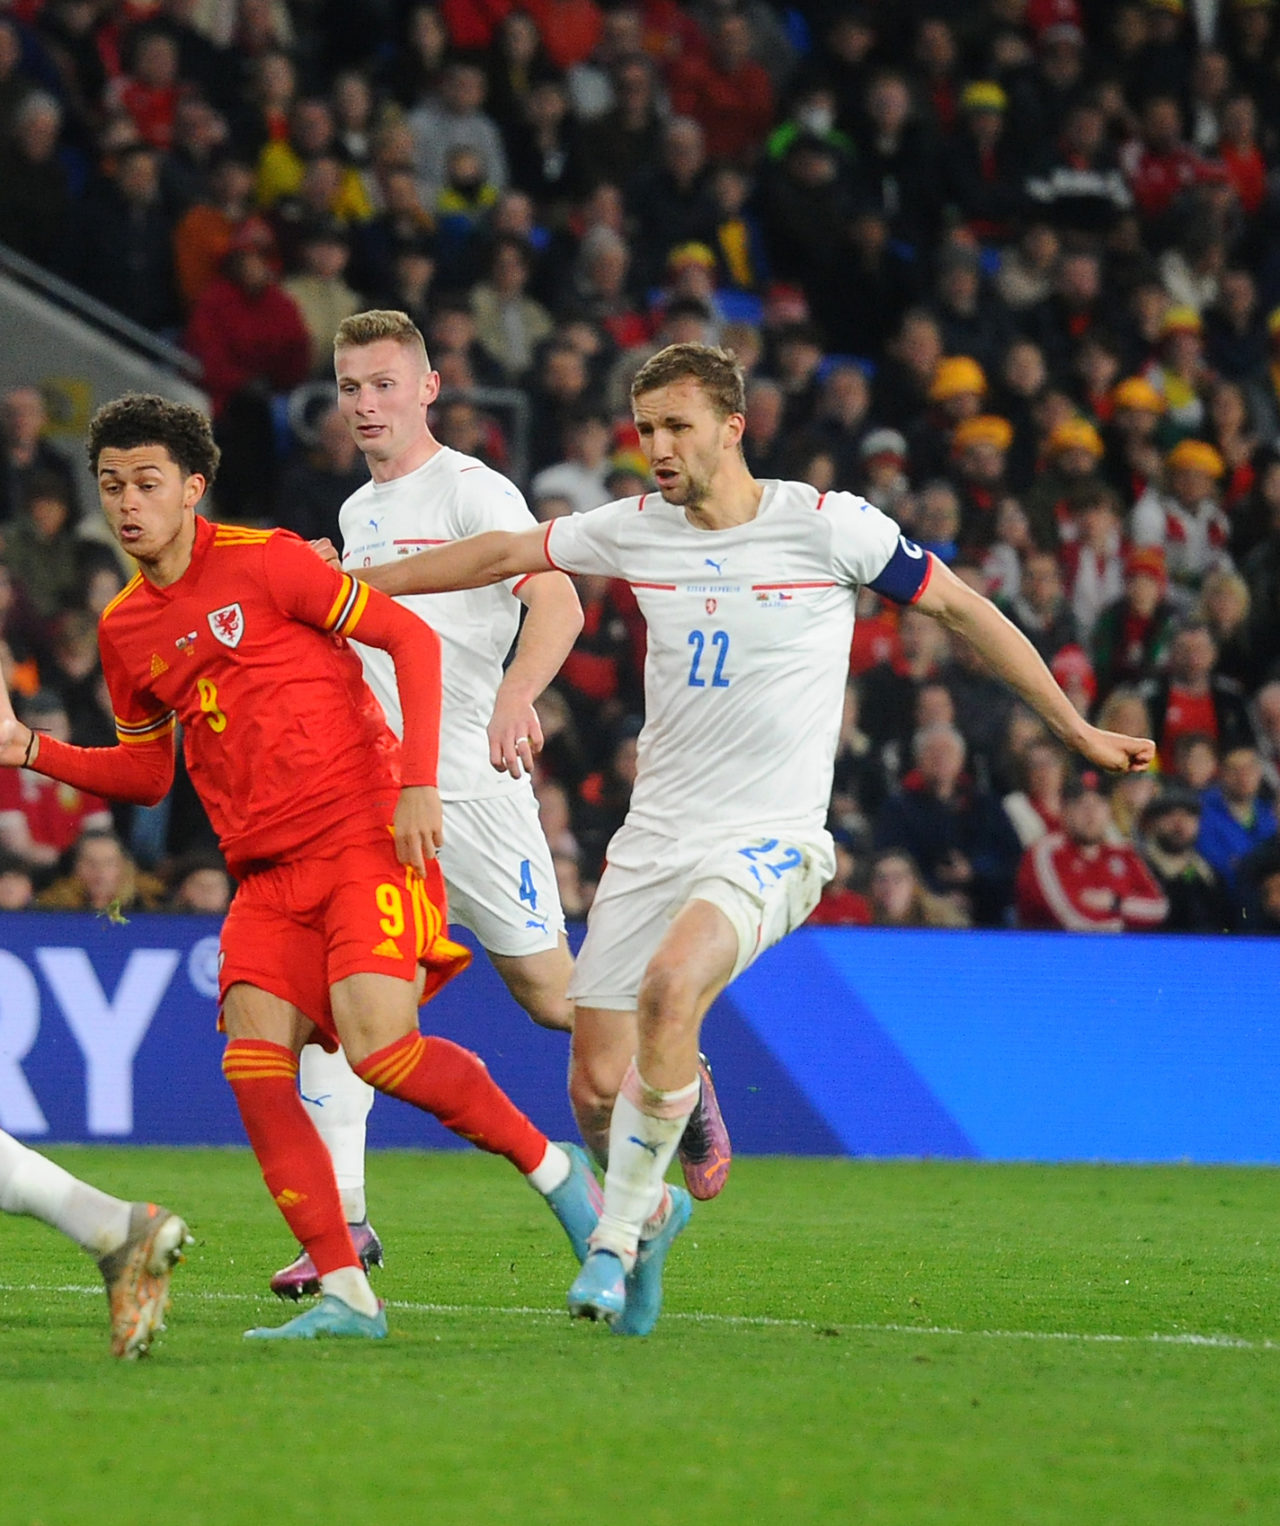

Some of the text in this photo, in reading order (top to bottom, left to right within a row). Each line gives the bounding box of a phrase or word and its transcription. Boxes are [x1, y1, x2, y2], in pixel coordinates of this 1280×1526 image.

[687, 629, 730, 688] 22
[197, 678, 227, 734] 9
[518, 859, 538, 911] 4
[735, 838, 803, 880] 22
[375, 882, 406, 937] 9
